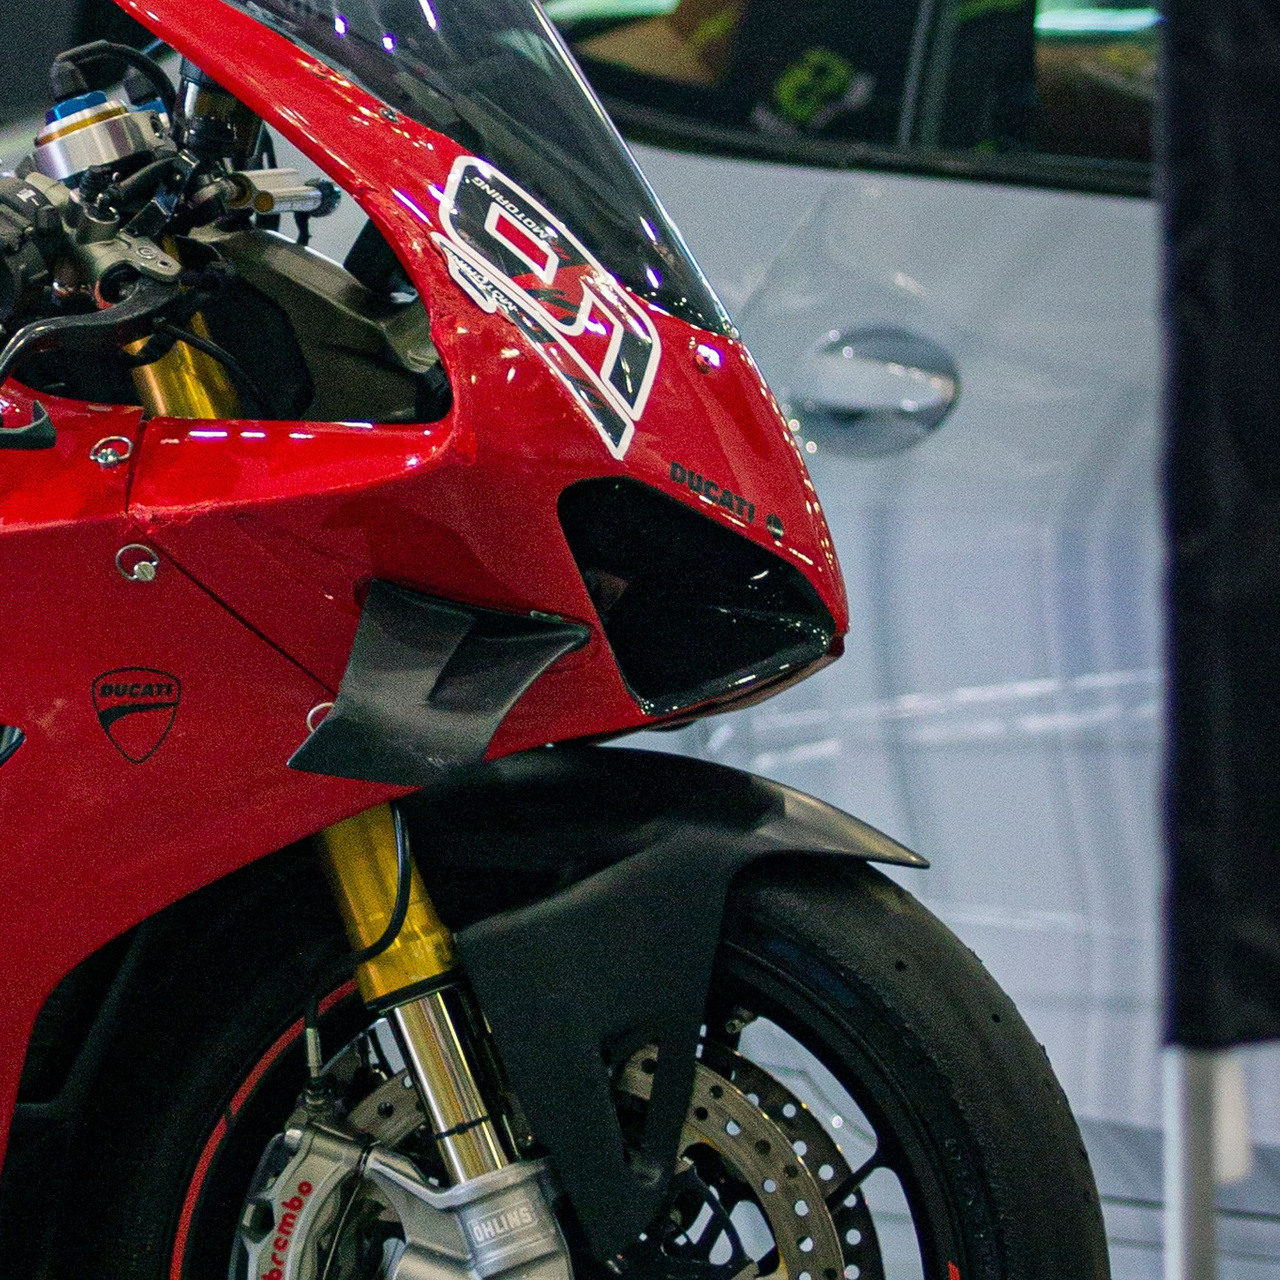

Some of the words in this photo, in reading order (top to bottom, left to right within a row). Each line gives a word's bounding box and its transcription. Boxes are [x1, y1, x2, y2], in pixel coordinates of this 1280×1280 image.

[472, 176, 552, 241] MOTORING
[670, 460, 755, 523] DUCATI
[100, 683, 174, 697] DUCATI
